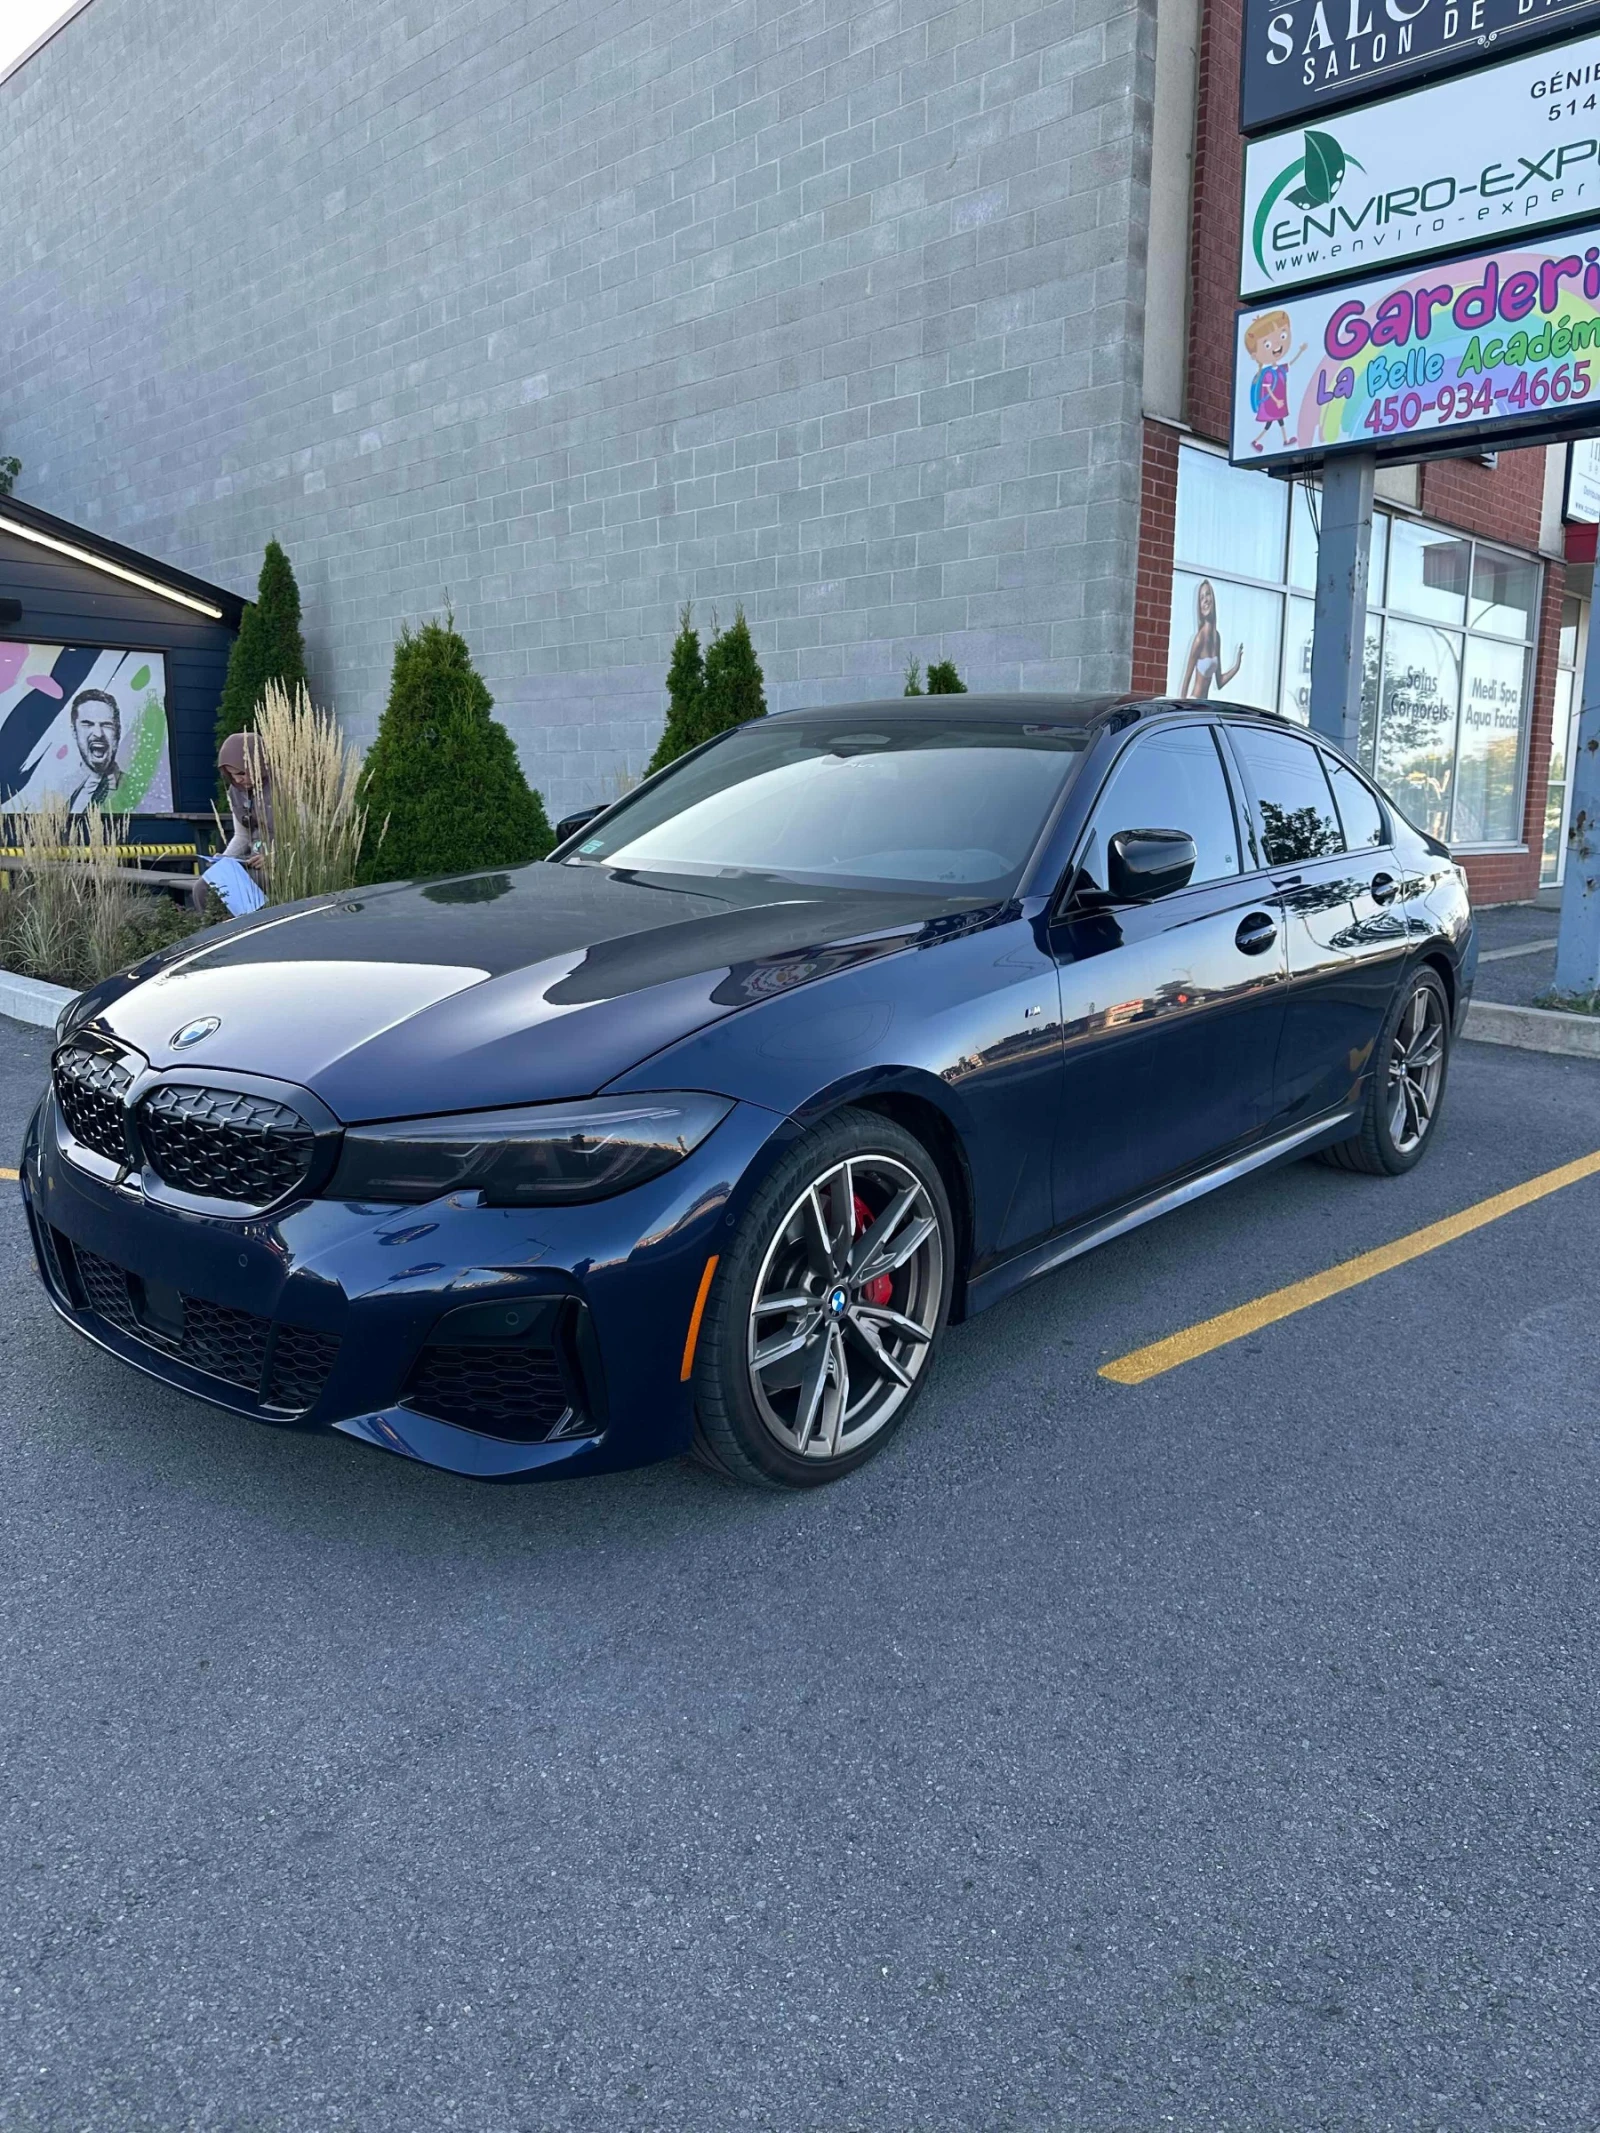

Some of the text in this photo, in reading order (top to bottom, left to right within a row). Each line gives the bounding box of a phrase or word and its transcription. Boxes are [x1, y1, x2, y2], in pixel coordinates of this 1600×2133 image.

[1302, 0, 1485, 86] SALON DE
[1548, 94, 1597, 121] 514
[1272, 139, 1600, 251] ENVIRO-EXP
[1317, 366, 1355, 405] La
[1366, 347, 1444, 397] Belle
[1364, 360, 1591, 434] 450-934-4665
[1406, 665, 1438, 692] Soins
[1472, 677, 1518, 706] Medi Spa
[1465, 704, 1491, 730] Aqua
